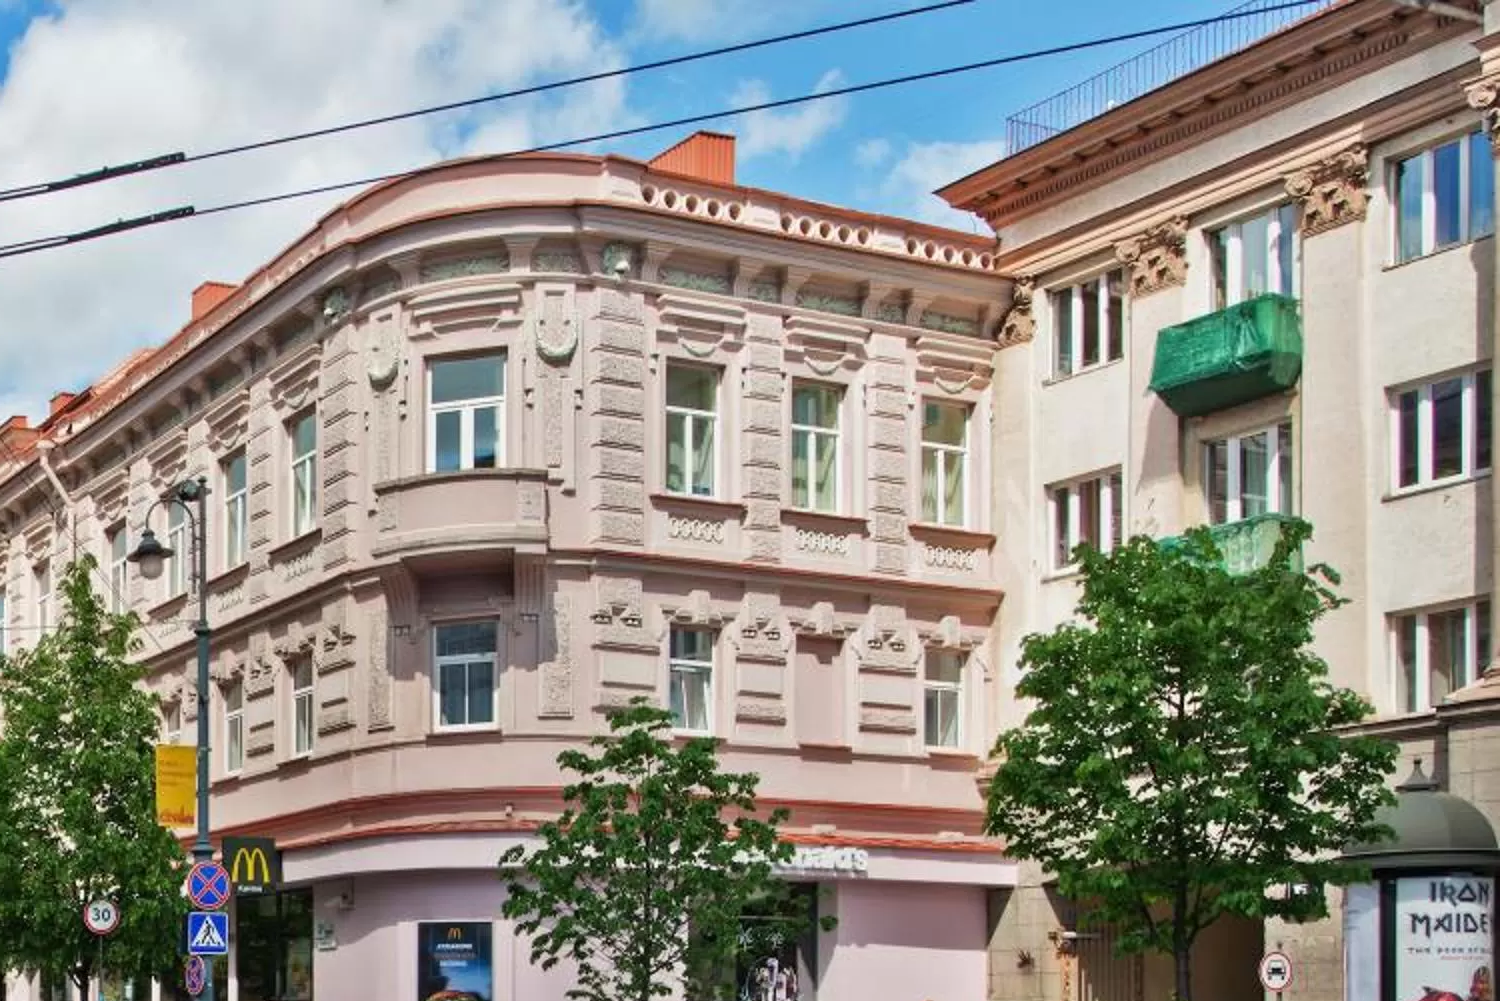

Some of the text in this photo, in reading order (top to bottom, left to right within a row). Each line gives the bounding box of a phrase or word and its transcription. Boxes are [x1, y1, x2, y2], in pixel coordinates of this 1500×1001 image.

[1429, 881, 1490, 907] IRON
[91, 906, 111, 922] 30
[1409, 913, 1489, 939] MAIDE
